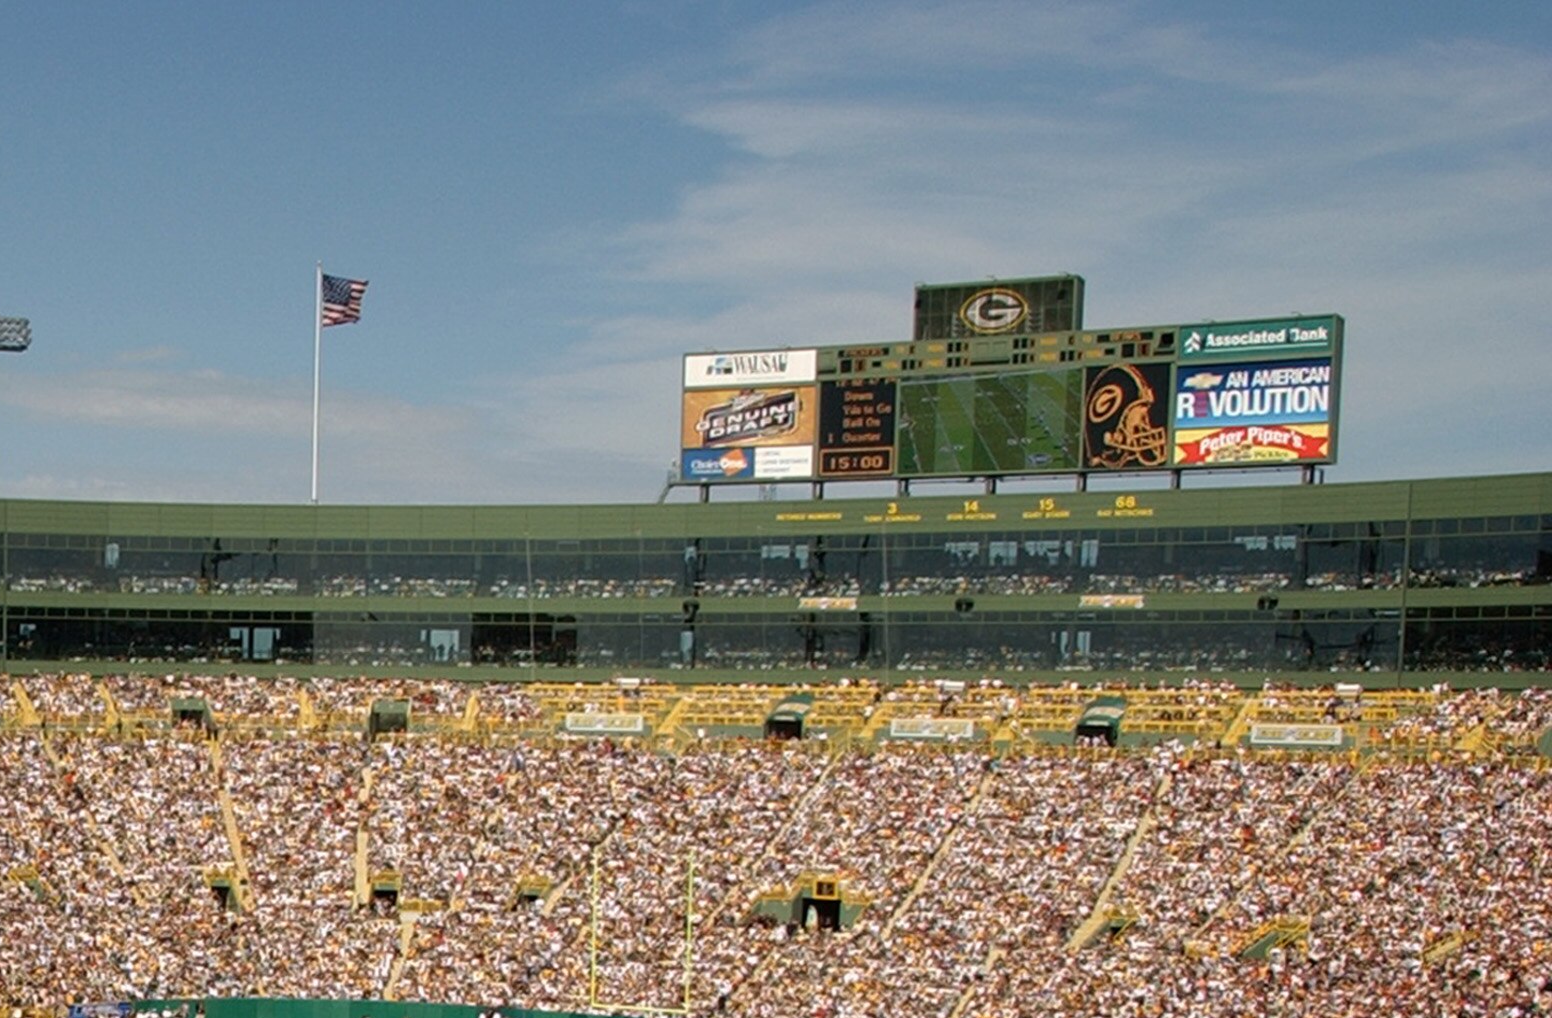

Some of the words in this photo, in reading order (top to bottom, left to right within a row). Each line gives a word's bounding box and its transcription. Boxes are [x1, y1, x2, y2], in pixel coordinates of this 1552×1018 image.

[1205, 329, 1286, 347] Associated
[1225, 371, 1248, 388] AN
[1251, 366, 1331, 387] AMERICAN
[1176, 385, 1329, 419] REVOLUTION
[709, 413, 788, 439] DRAFT
[830, 455, 883, 470] 15:00
[886, 501, 898, 515] 3
[963, 500, 979, 513] 14
[1115, 496, 1136, 509] 68
